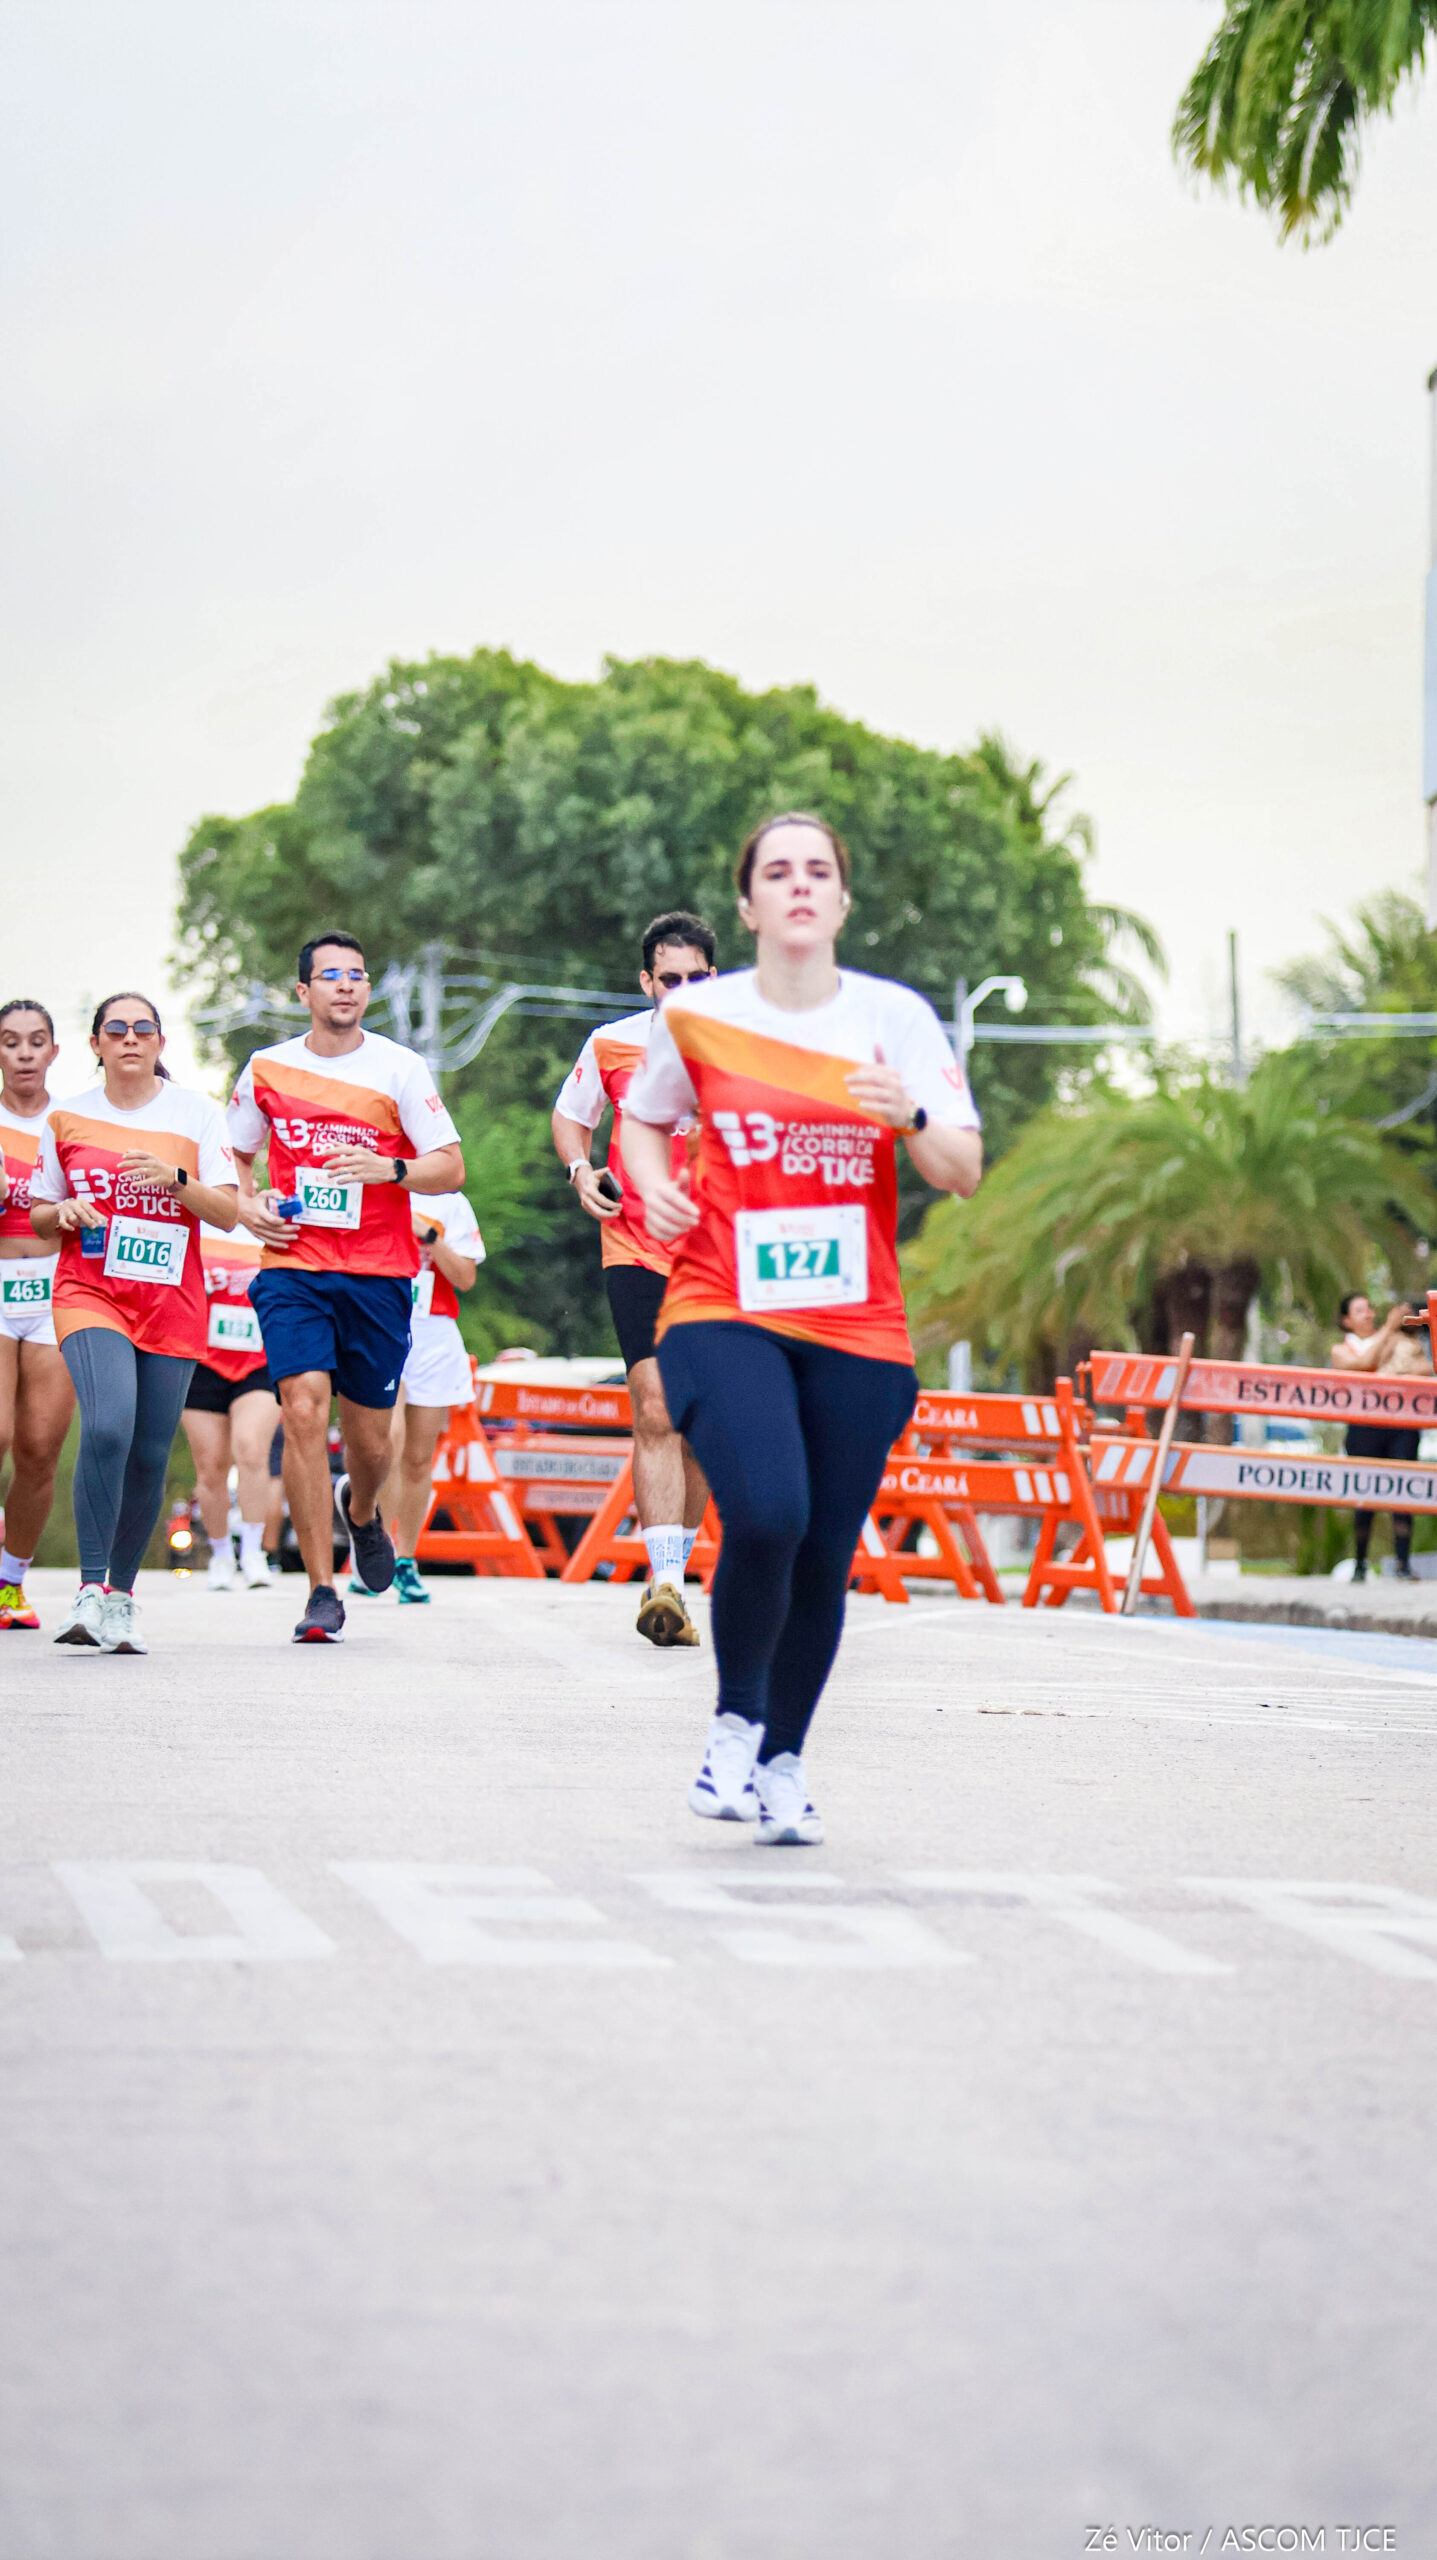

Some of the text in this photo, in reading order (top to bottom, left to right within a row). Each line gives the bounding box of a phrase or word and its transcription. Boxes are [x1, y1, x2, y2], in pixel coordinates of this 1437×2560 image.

[316, 1122, 379, 1137] CAMINHADA
[788, 1122, 881, 1139] CAMINHADA
[782, 1153, 875, 1186] DO TJCE
[116, 1195, 181, 1217] DO TJCE
[308, 1187, 342, 1210] 260
[121, 1238, 171, 1265] 1016
[768, 1240, 831, 1279] 127
[9, 1279, 45, 1301] 463
[1237, 1380, 1352, 1408] ESTADO
[1361, 1389, 1404, 1413] DO
[900, 1466, 970, 1496] CEARÁ
[1237, 1463, 1437, 1499] PODER JUDICI
